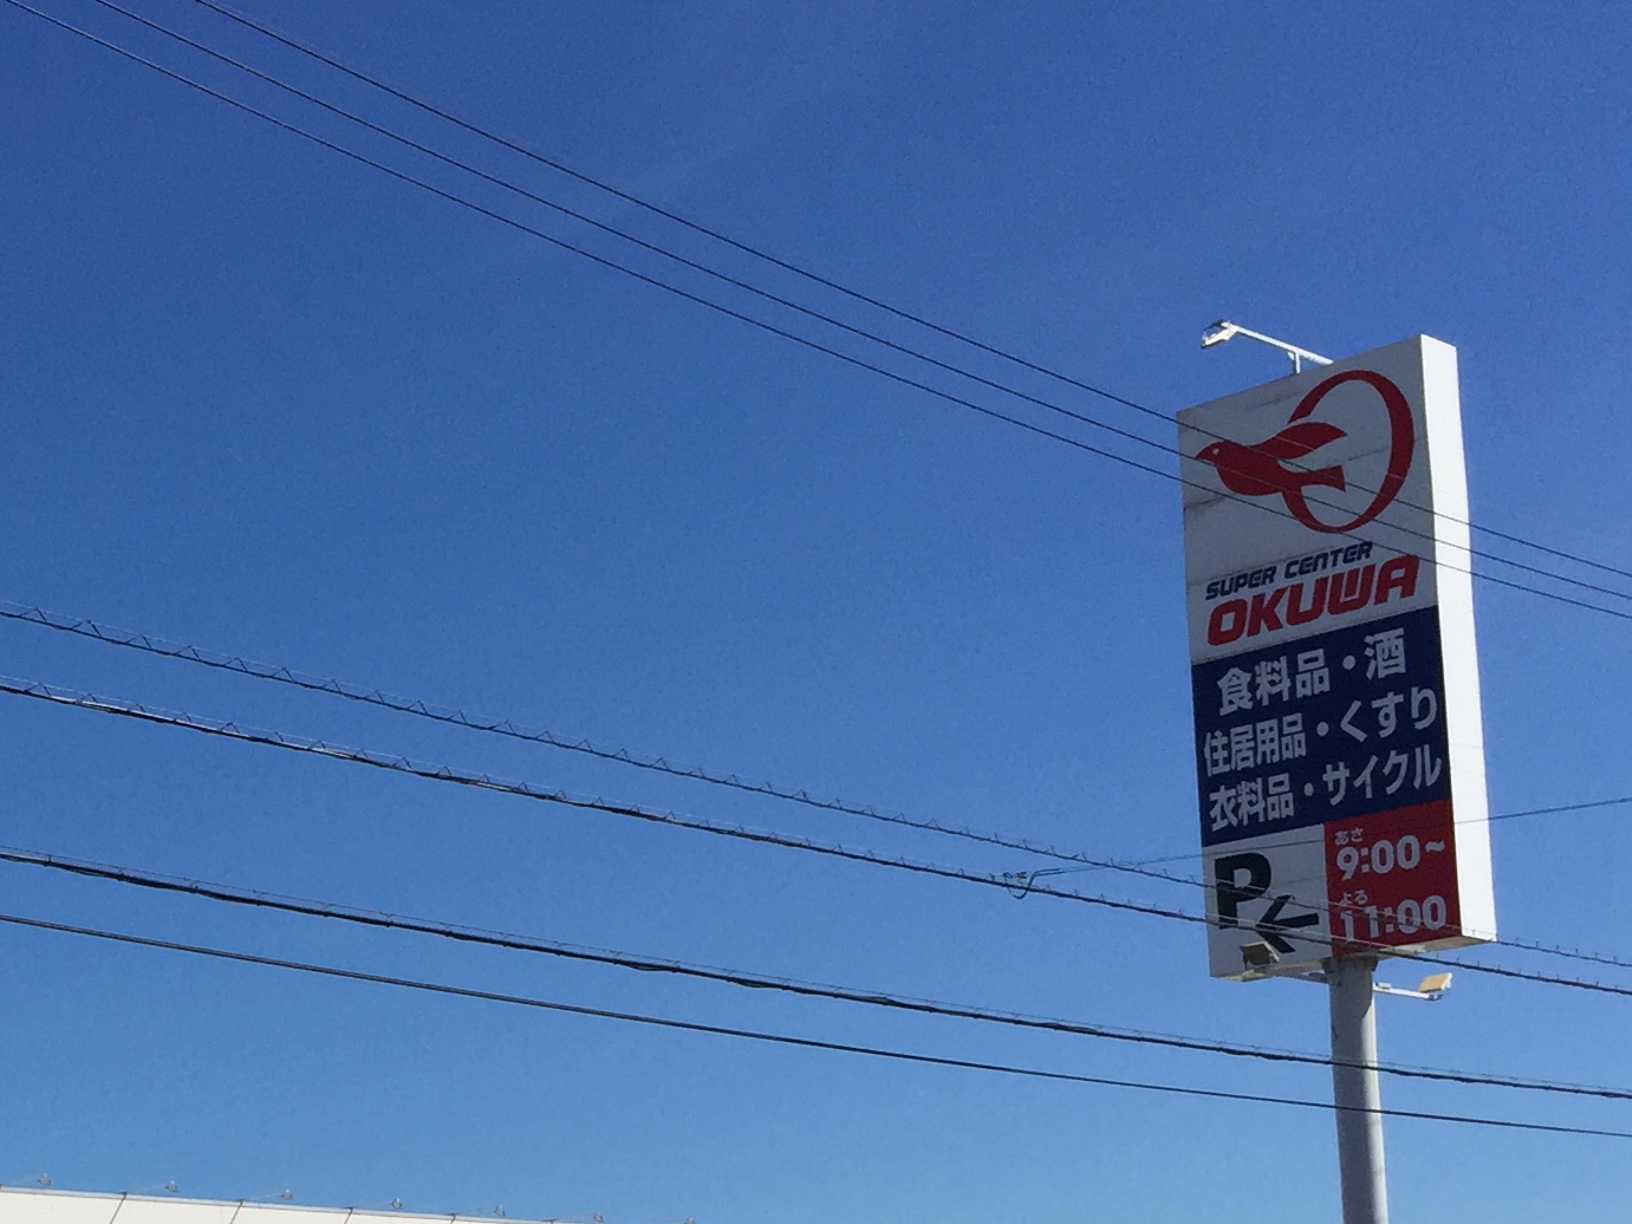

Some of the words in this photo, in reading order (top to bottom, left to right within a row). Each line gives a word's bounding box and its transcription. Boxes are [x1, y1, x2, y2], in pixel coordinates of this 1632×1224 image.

[1205, 565, 1277, 600] SUPER
[1284, 541, 1374, 580] CENTER
[1207, 554, 1420, 647] OKUWA
[1217, 627, 1406, 717] 食料品・酒
[1203, 686, 1438, 777] 住居用品・くすり
[1209, 744, 1442, 832] 衣料品・サイクル
[1335, 827, 1364, 845] あさ
[1214, 852, 1272, 930] P
[1339, 890, 1368, 907] よる
[1339, 895, 1447, 944] 11:00
